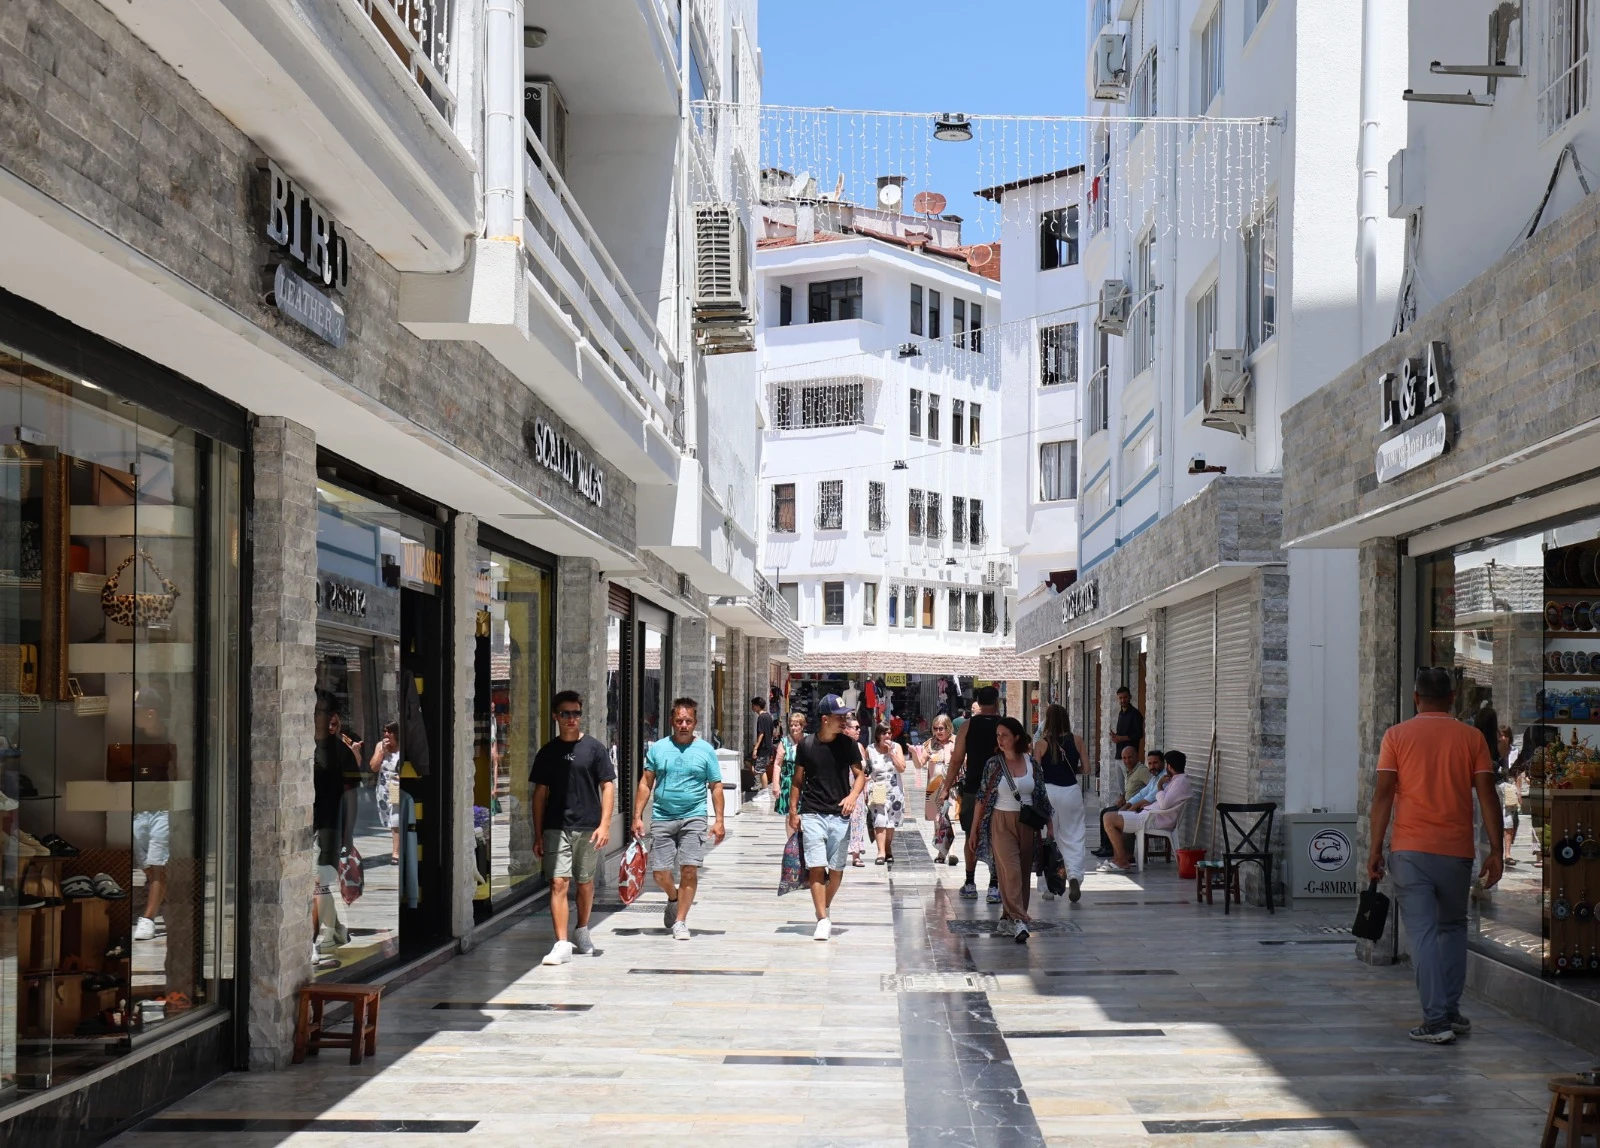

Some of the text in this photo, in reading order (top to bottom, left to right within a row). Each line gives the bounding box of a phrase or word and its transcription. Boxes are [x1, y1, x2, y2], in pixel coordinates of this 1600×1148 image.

[267, 159, 352, 296] BIRD
[279, 273, 341, 339] LEATHER 3
[534, 416, 604, 508] SCALLY WAGS
[415, 545, 442, 586] HASSLE
[886, 675, 905, 684] ANGEL'S
